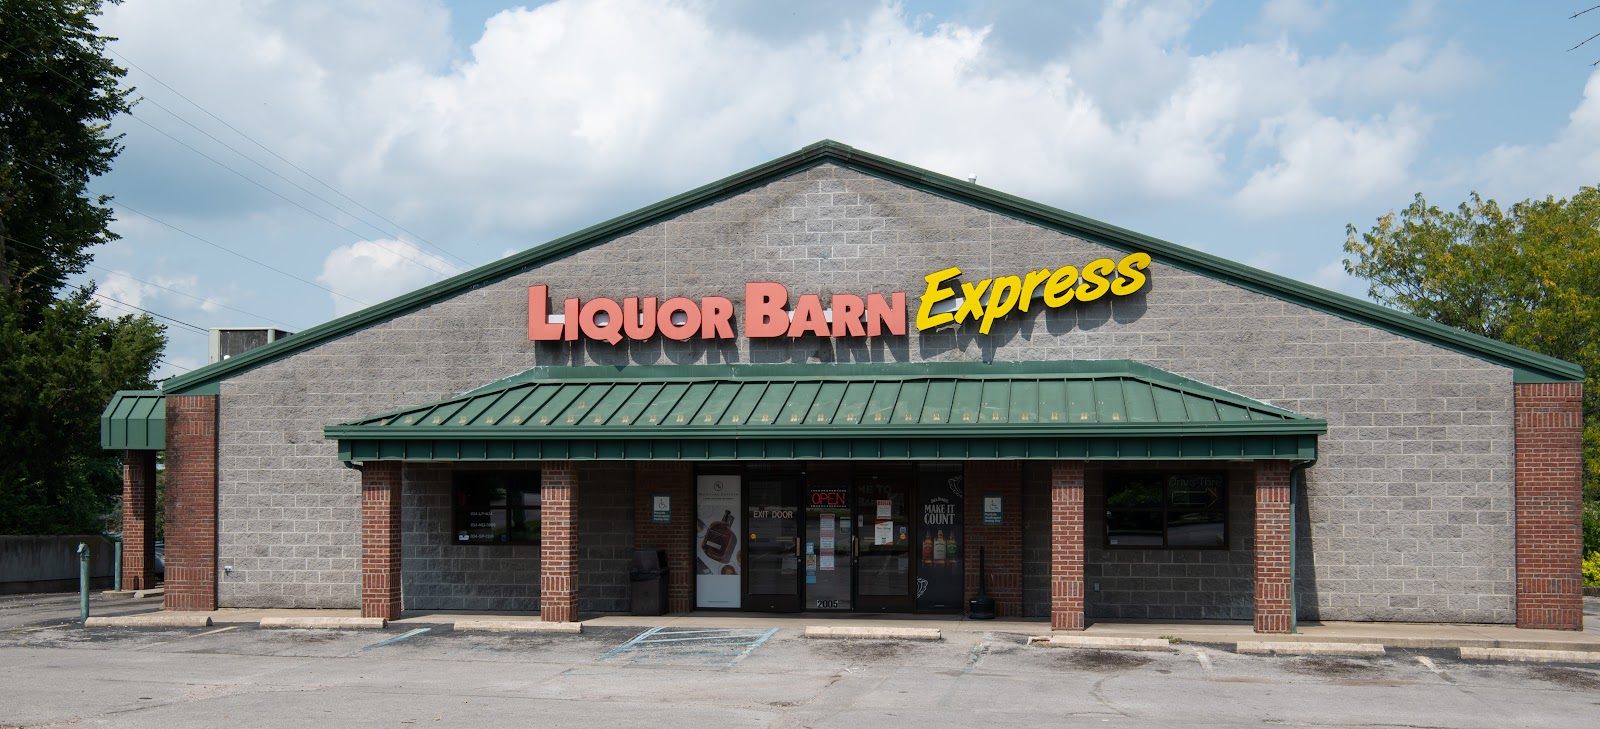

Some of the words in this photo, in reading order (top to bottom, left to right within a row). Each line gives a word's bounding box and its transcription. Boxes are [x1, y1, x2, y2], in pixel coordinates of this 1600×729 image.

[528, 285, 735, 346] LIQUOR
[745, 282, 907, 338] BARN
[916, 252, 1152, 335] Express
[811, 492, 846, 505] OPEN
[924, 504, 945, 513] MAKE
[947, 504, 956, 513] IT
[753, 510, 769, 519] EXIT
[771, 510, 793, 519] DOOR
[923, 513, 956, 525] COUNT
[816, 599, 838, 608] 2005
